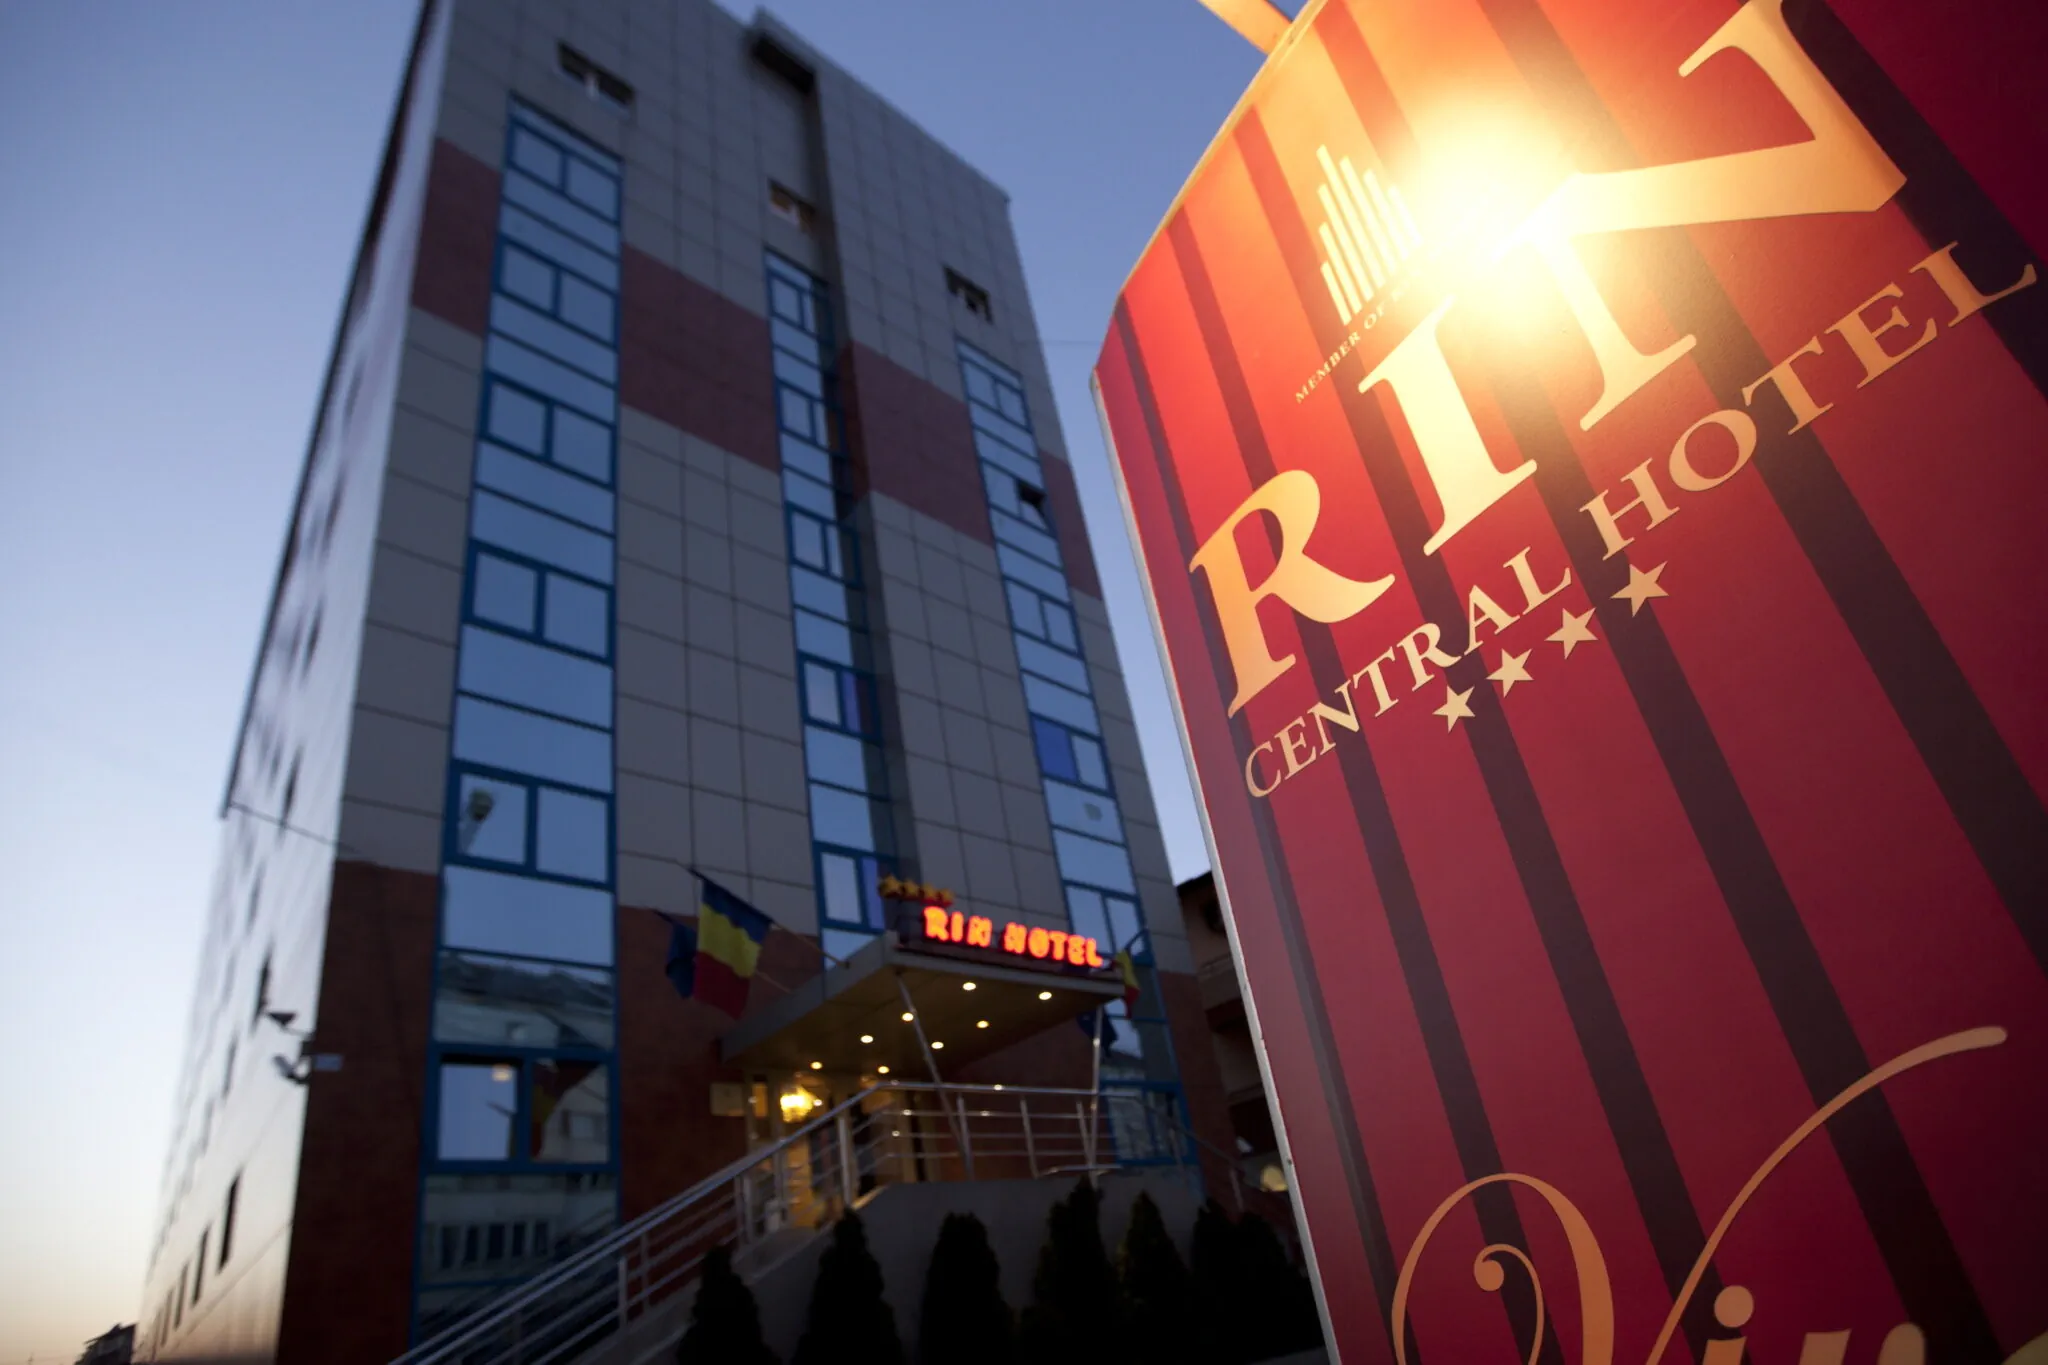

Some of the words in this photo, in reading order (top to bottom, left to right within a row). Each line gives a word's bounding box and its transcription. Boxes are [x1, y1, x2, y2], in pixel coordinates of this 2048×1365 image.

[1189, 0, 1907, 719] RIN
[1295, 331, 1361, 404] MEMBER
[1244, 546, 1572, 798] CENTRAL
[1579, 241, 2038, 562] HOTEL
[923, 905, 992, 948] RIN
[1003, 922, 1103, 968] HOTEL
